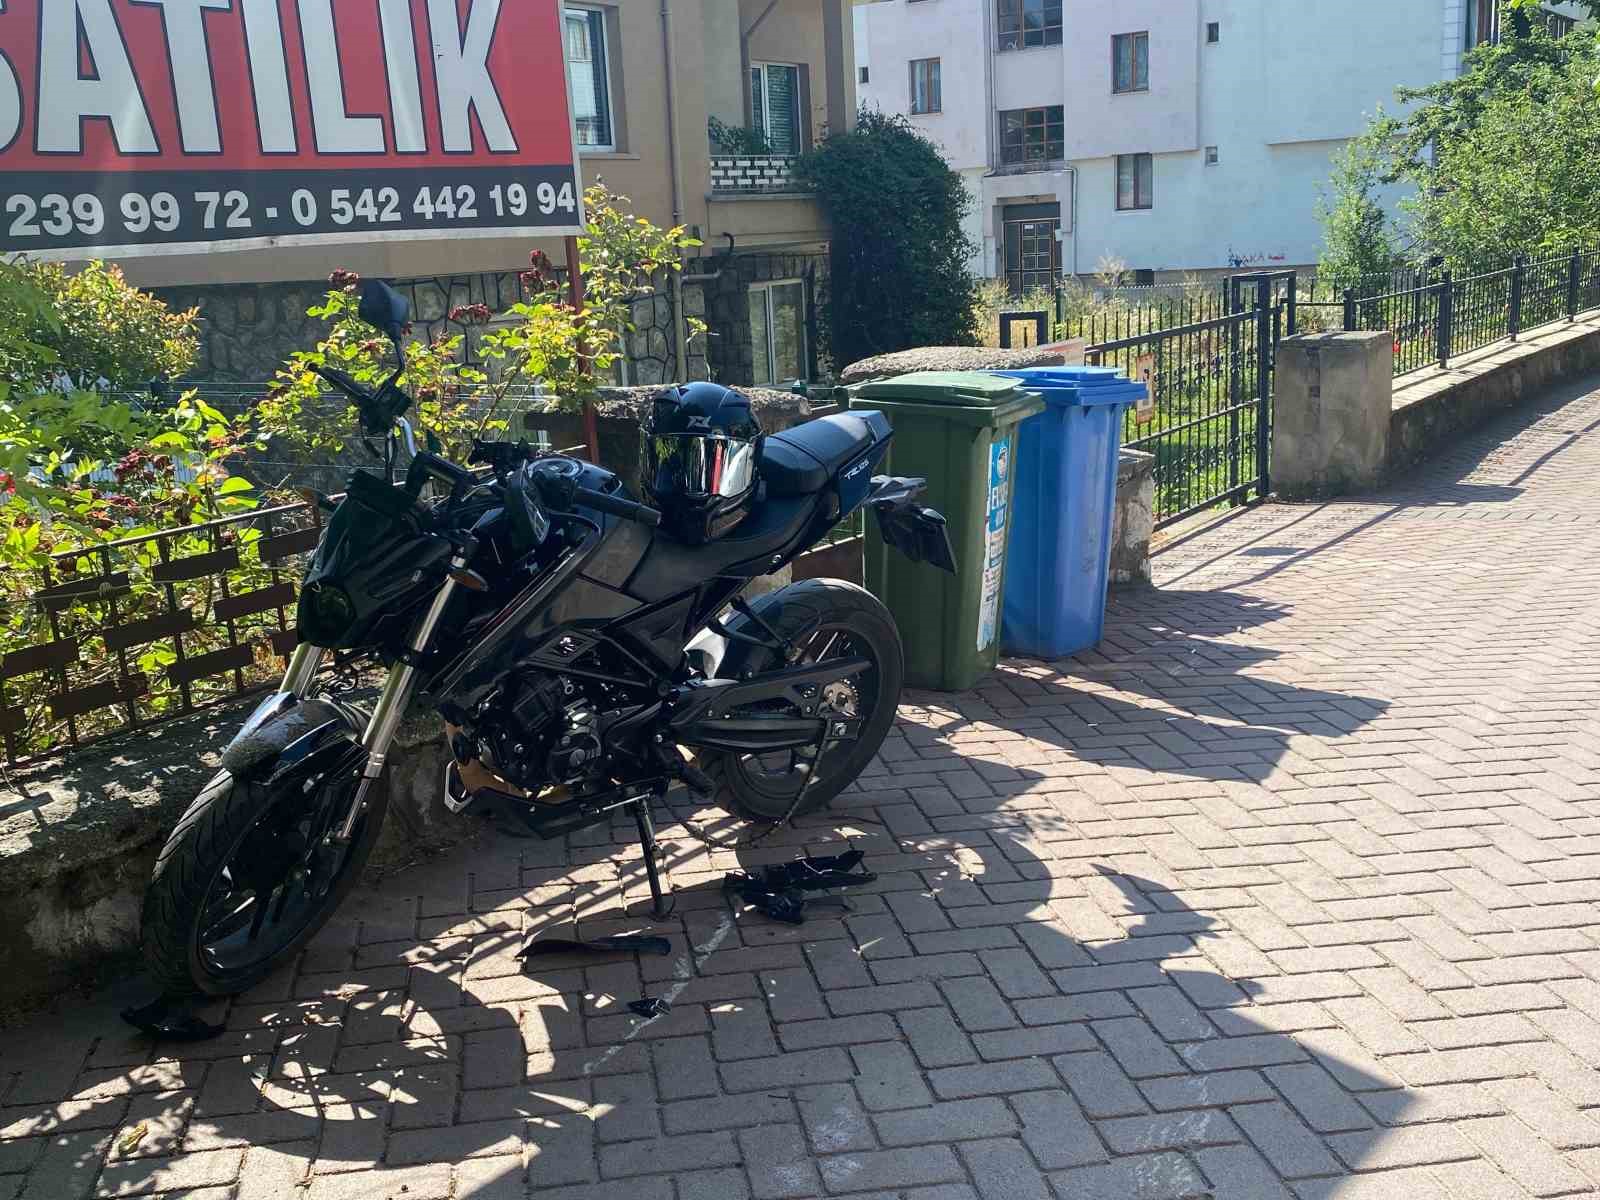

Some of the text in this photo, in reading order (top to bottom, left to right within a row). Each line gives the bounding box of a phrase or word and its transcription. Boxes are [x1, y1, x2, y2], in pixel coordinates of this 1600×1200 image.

[6, 194, 105, 237] 239
[122, 192, 180, 233] 99
[194, 190, 252, 229] 72
[290, 188, 318, 226] 0
[329, 187, 401, 224] 542
[412, 185, 478, 220] 442
[488, 183, 527, 217] 19
[535, 181, 577, 216] 94
